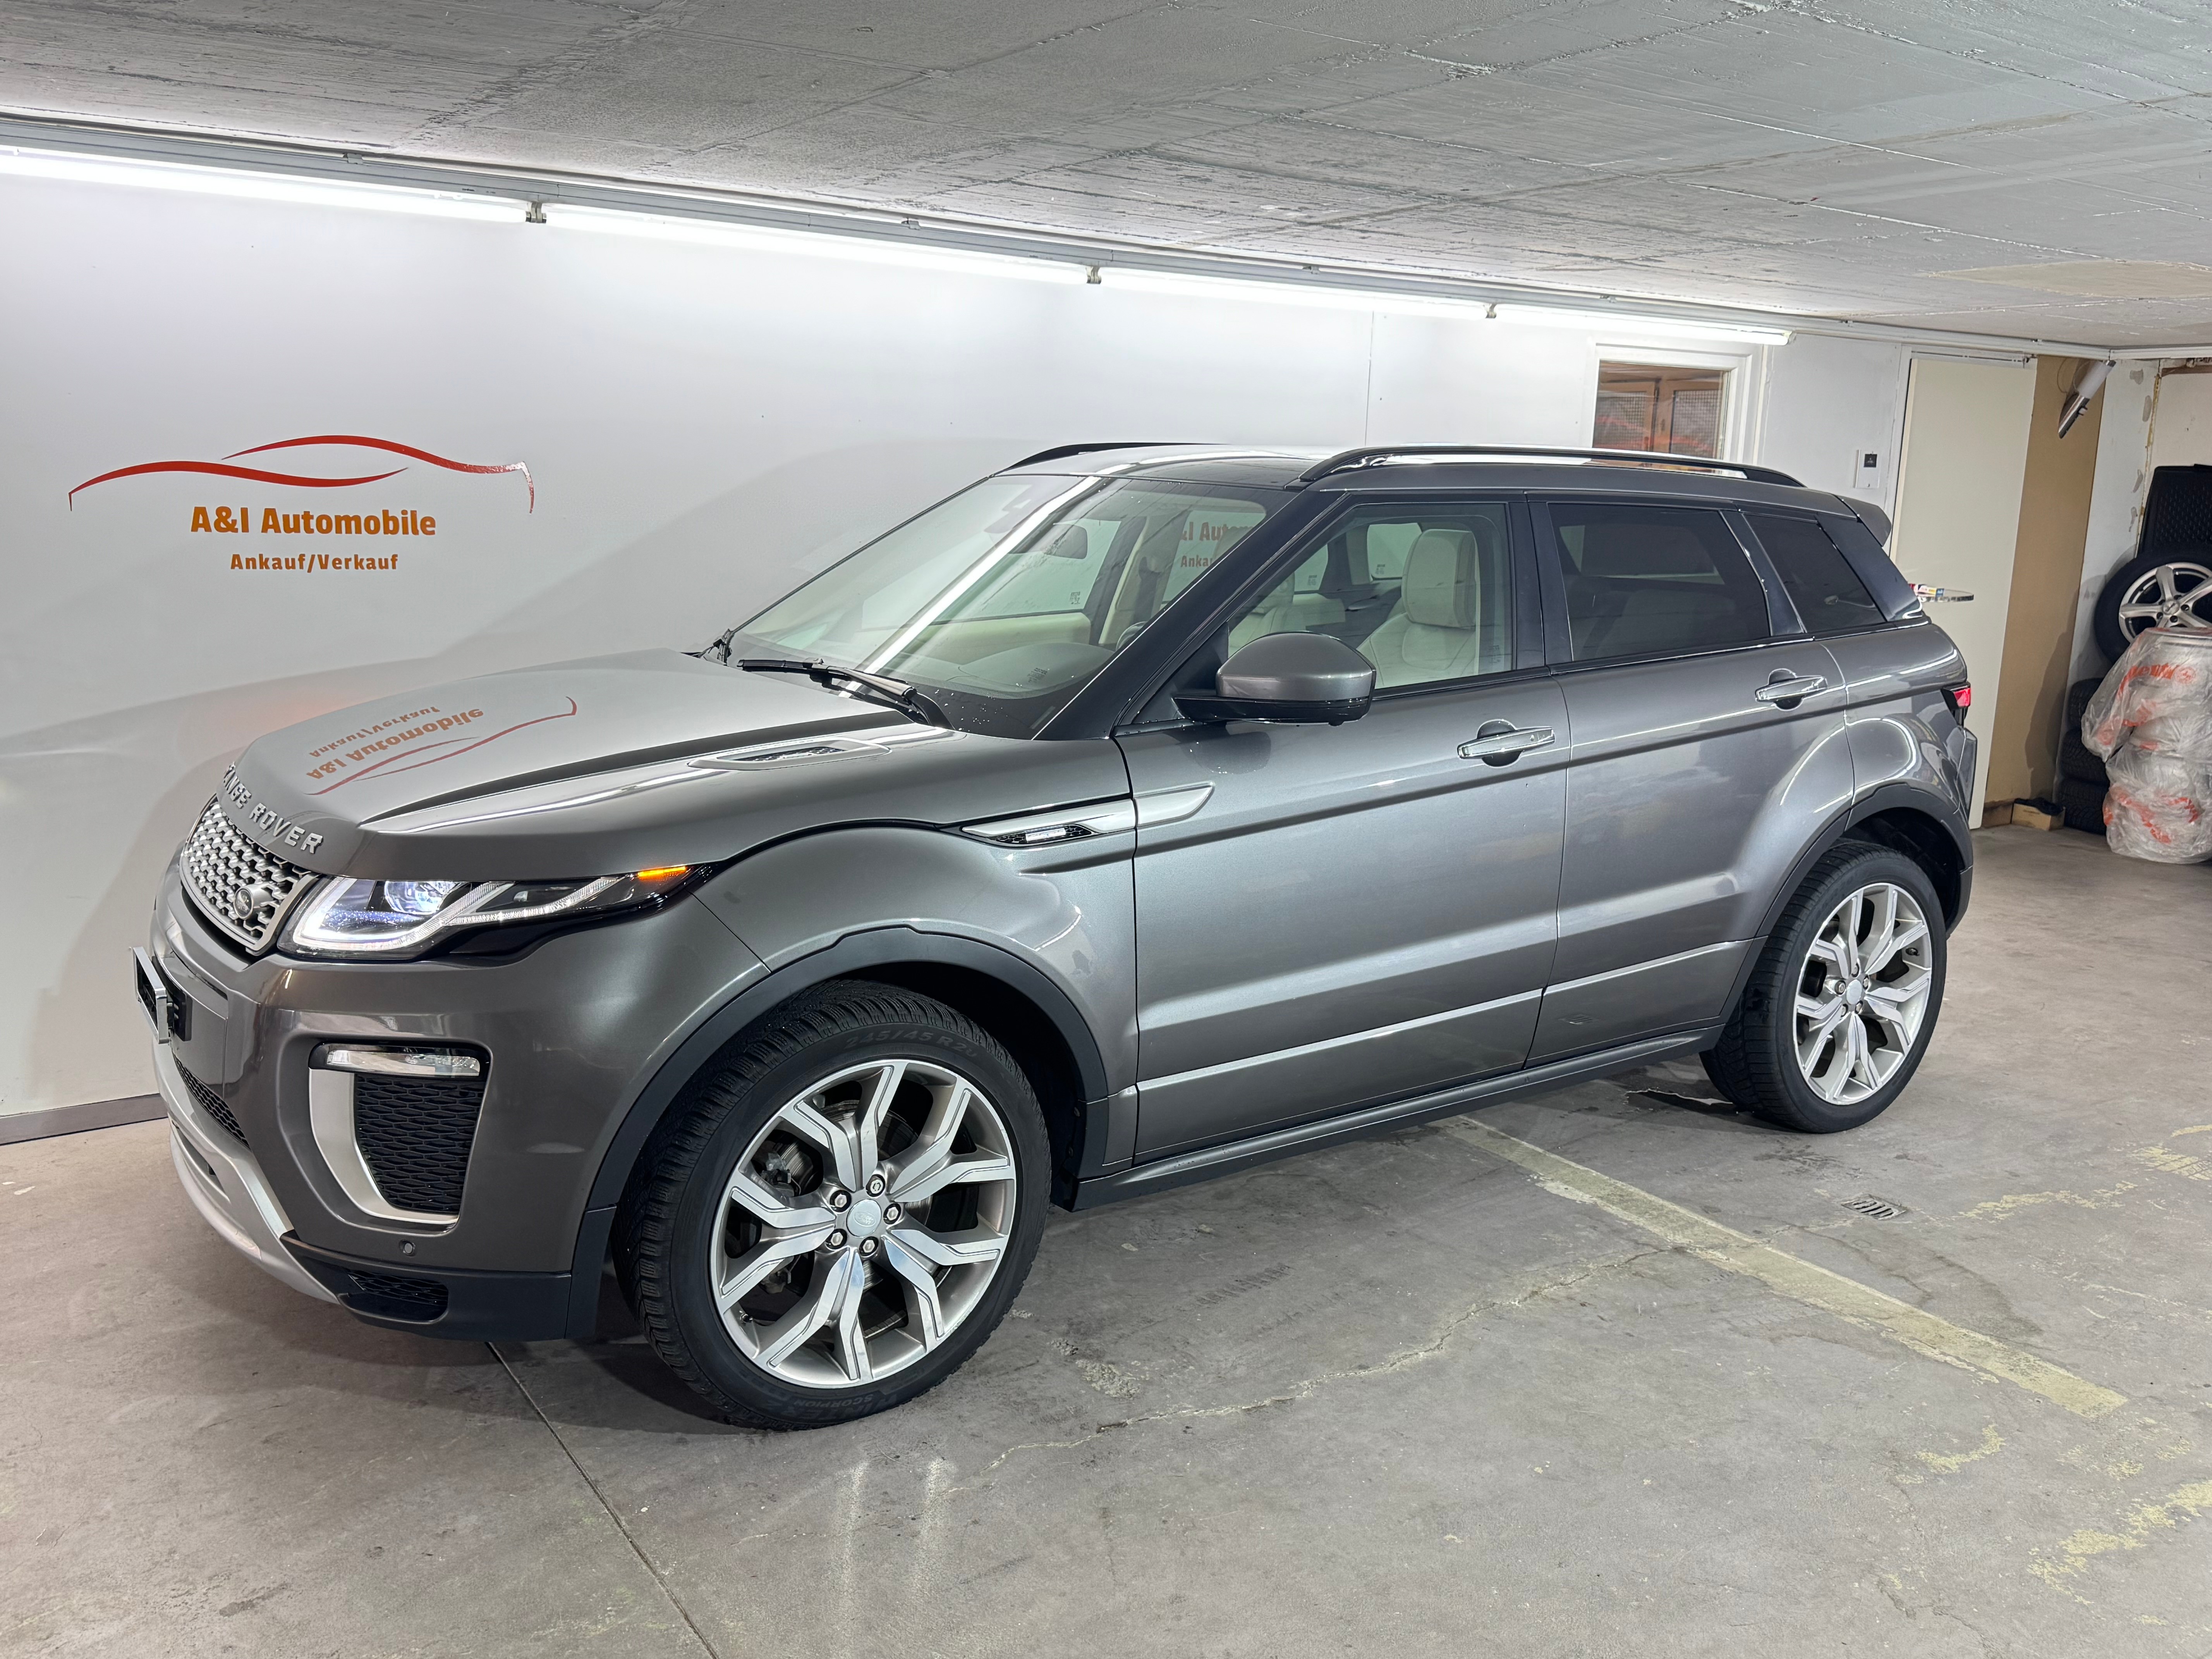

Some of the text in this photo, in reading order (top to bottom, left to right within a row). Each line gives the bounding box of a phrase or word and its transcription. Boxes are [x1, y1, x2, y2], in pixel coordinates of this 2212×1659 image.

[191, 506, 436, 536] A&I Automobile
[231, 553, 398, 573] Ankauf/Verkauf
[249, 803, 323, 854] ROVER
[844, 1029, 934, 1049] 245/45
[793, 1394, 874, 1407] SCORPION
